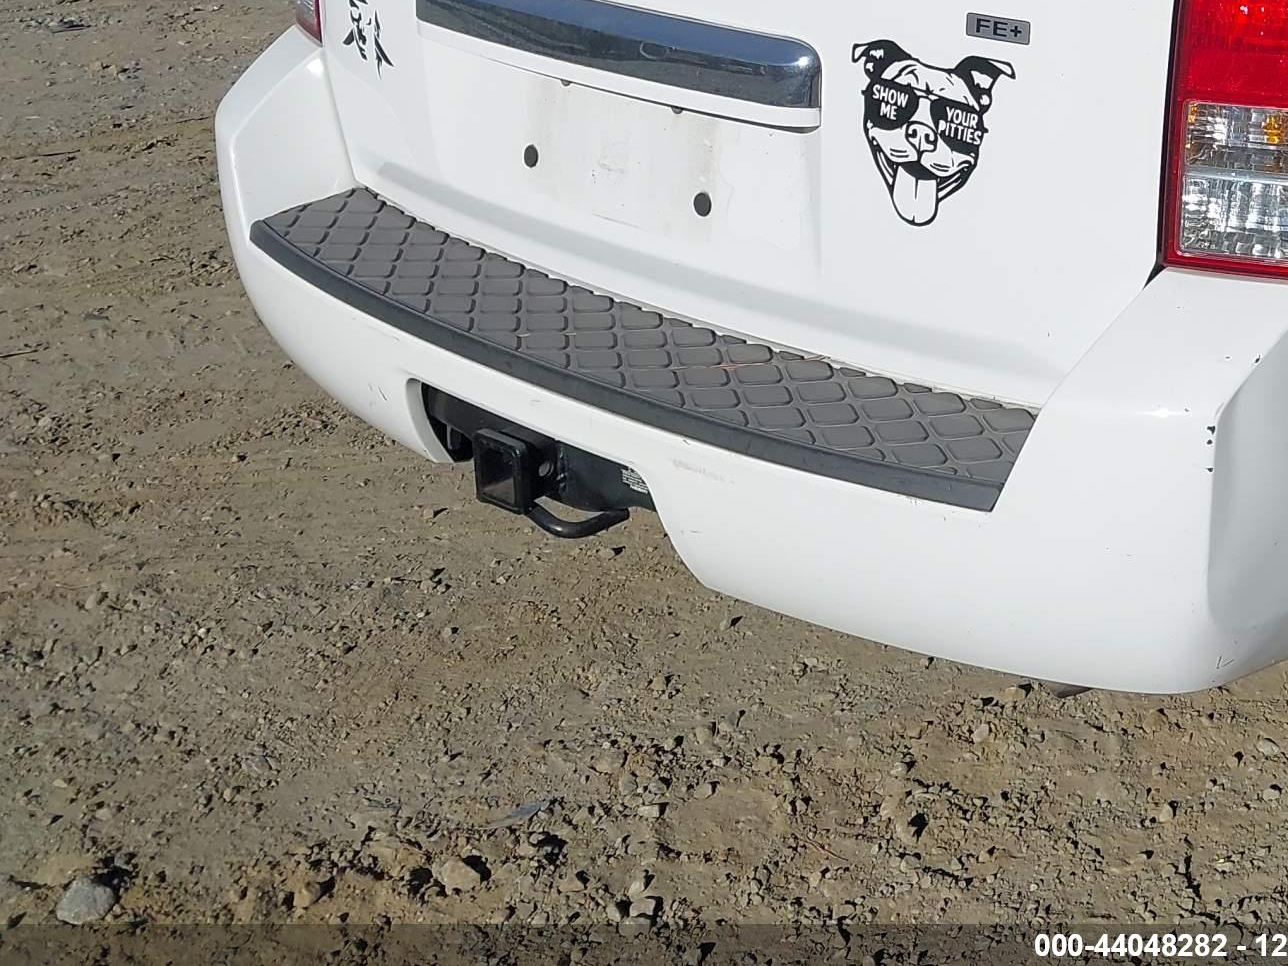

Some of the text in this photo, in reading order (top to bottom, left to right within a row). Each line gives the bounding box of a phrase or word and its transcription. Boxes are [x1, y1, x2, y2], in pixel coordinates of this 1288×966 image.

[976, 17, 1023, 38] FE+
[872, 84, 909, 108] SHOW
[879, 102, 898, 121] ME
[946, 106, 978, 129] YOUR
[938, 119, 982, 145] PITTIES
